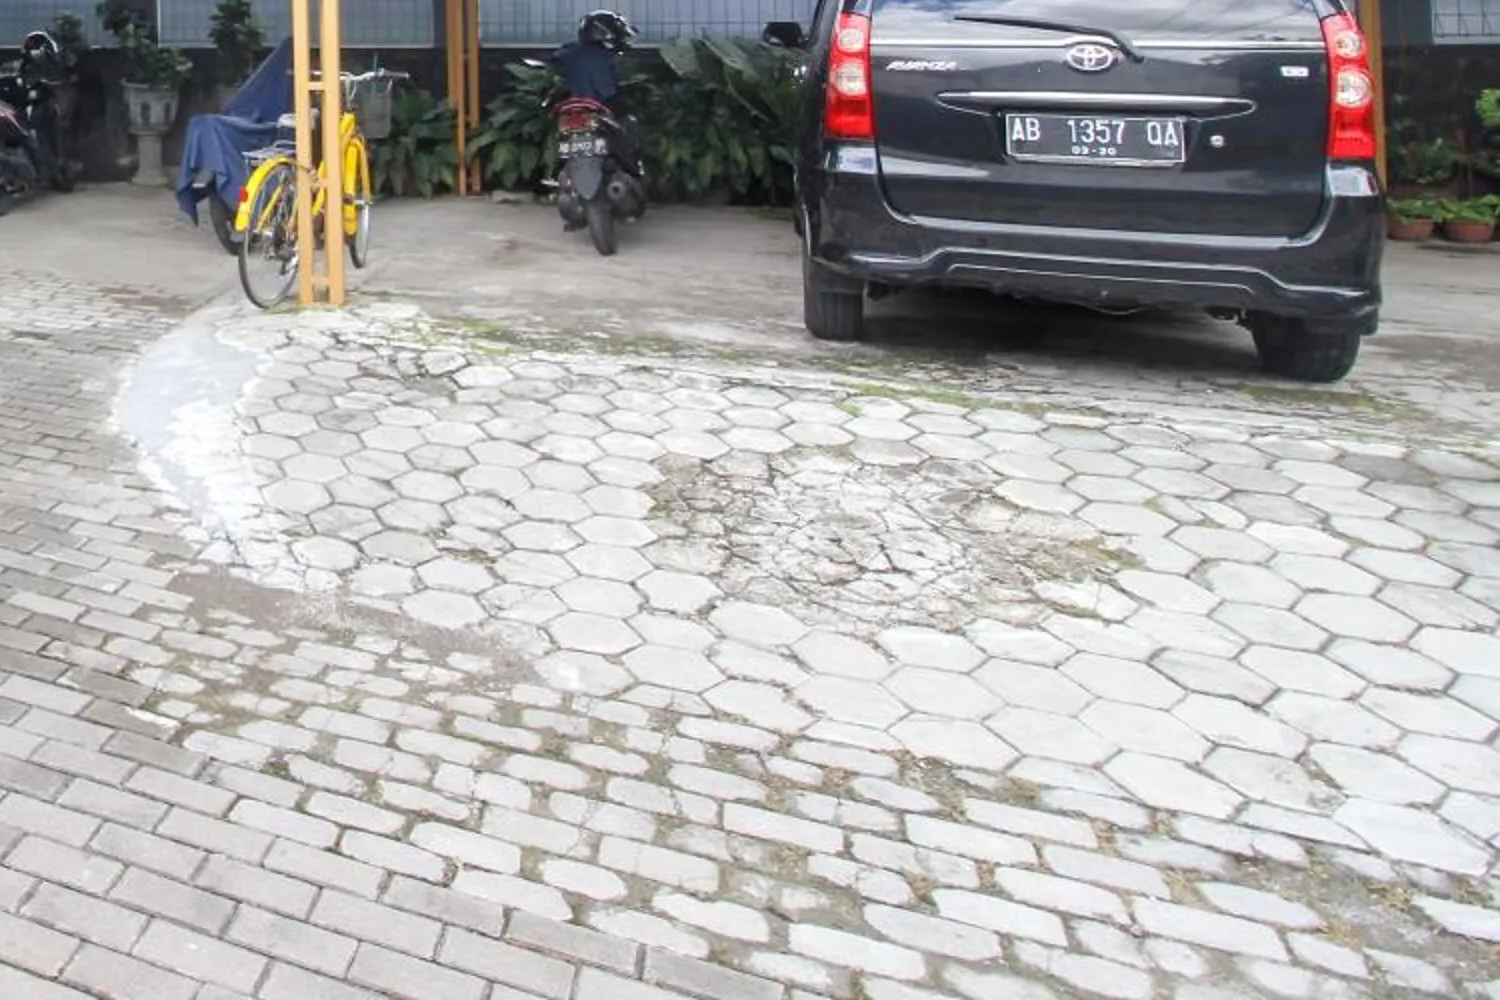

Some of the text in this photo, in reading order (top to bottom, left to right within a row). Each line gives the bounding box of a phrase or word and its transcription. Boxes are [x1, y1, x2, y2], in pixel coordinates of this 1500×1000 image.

[1011, 117, 1180, 146] AB 1357 QA
